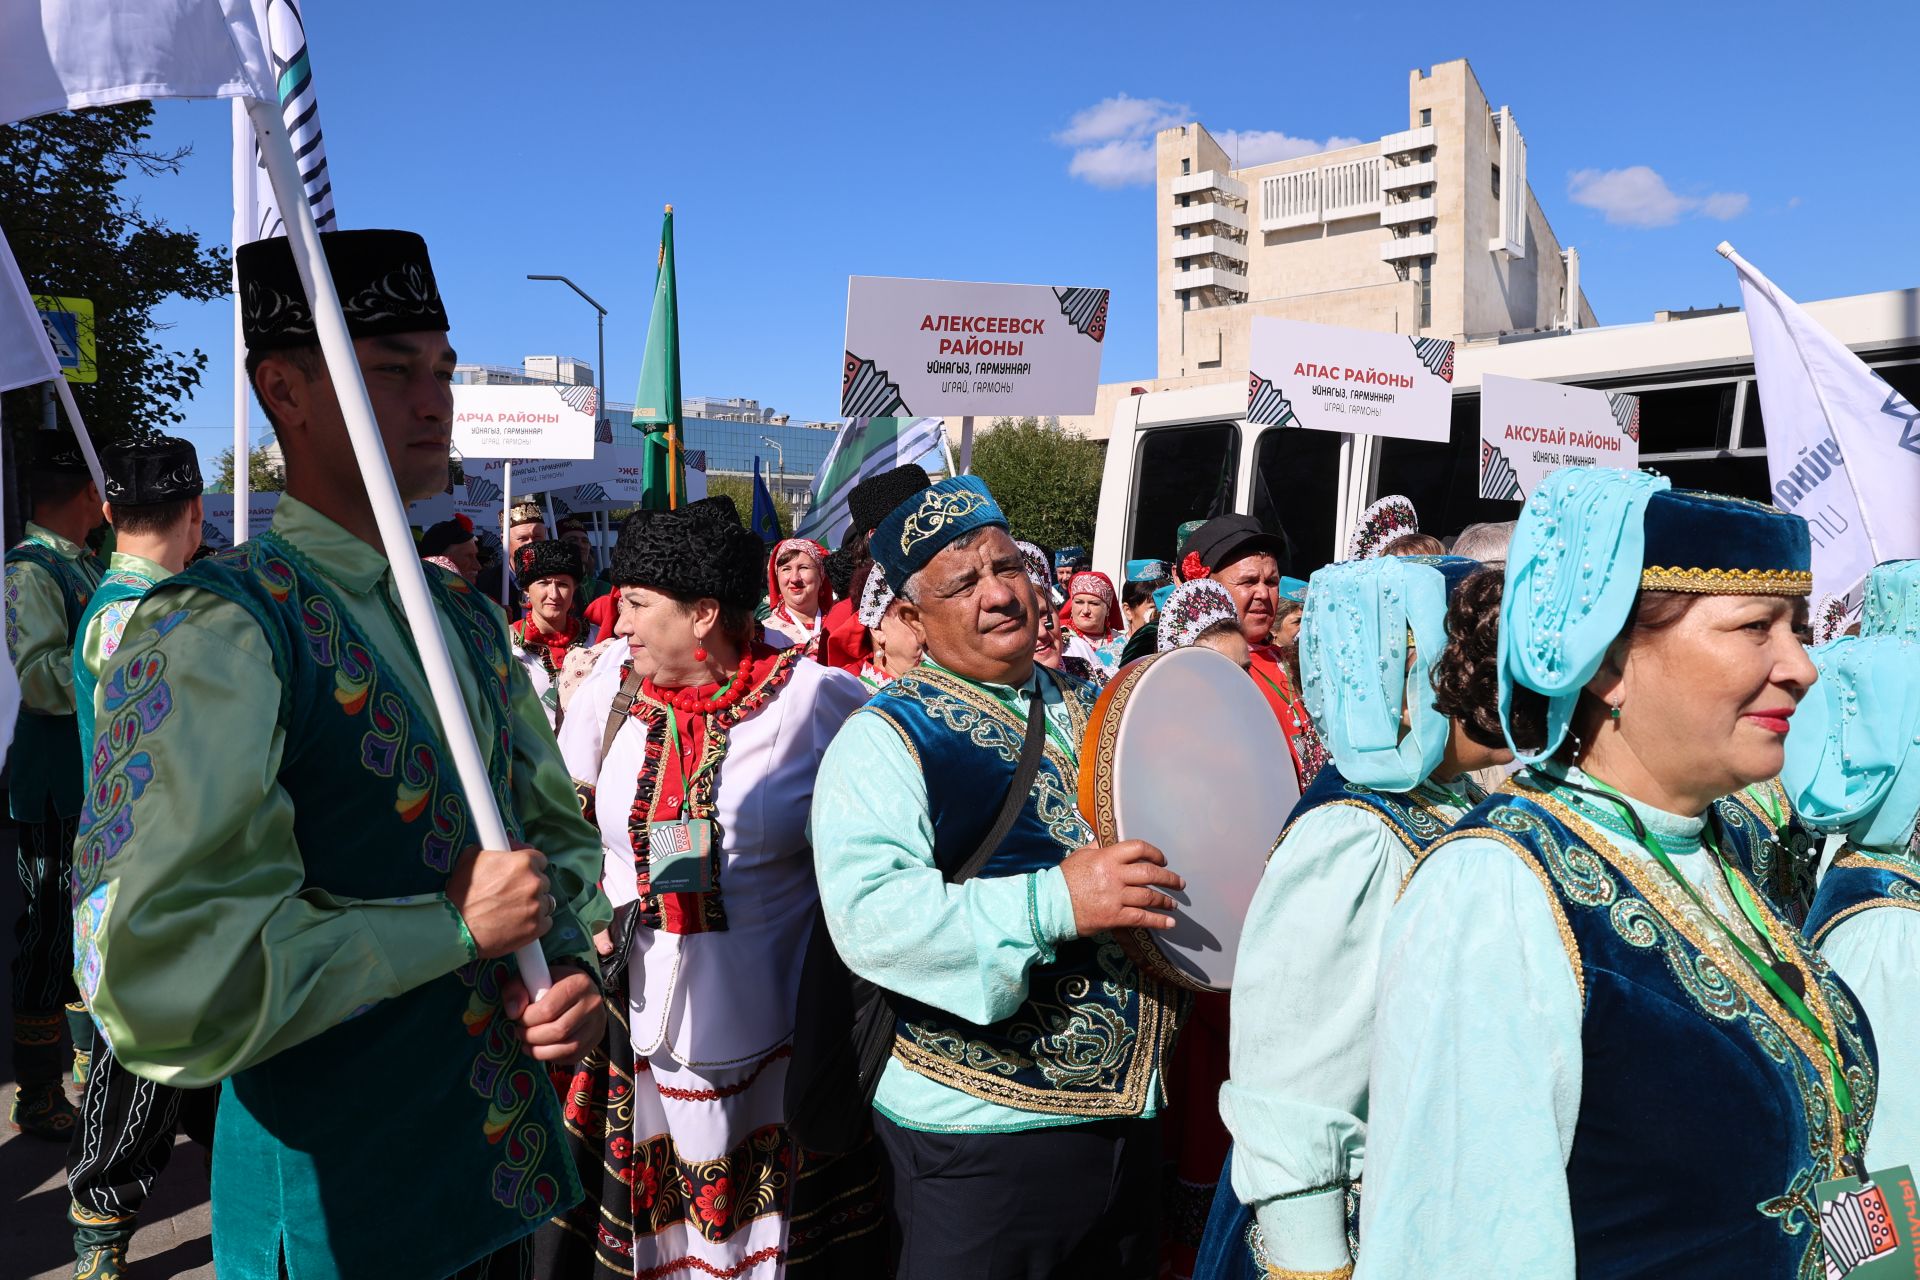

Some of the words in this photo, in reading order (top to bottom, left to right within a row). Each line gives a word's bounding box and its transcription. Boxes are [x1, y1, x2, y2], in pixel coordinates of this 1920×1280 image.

[920, 314, 1045, 335] АЛЕКСЕЕВСК
[939, 335, 1024, 356] РАЙОНЫ
[926, 360, 972, 375] УЙНАГЫЗ,
[975, 362, 1031, 375] ГАРМУННАР!
[1293, 362, 1340, 380] АПАС
[1344, 368, 1414, 389] РАЙОНЫ
[942, 380, 970, 394] ИГРАЙ,
[972, 381, 1014, 393] ГАРМОНЬ!
[1311, 385, 1348, 399] УЙНАГЫЗ,
[1350, 390, 1395, 403] ГАРМУННАР!
[456, 413, 494, 423] АРЧА
[498, 411, 559, 423] РАЙОНЫ
[471, 427, 502, 435] УЙНАГЫЗ,
[1504, 424, 1566, 445] АКСУБАЙ
[1569, 430, 1621, 451] РАЙОНЫ
[1532, 450, 1561, 466] УЙНАГЫЗ,
